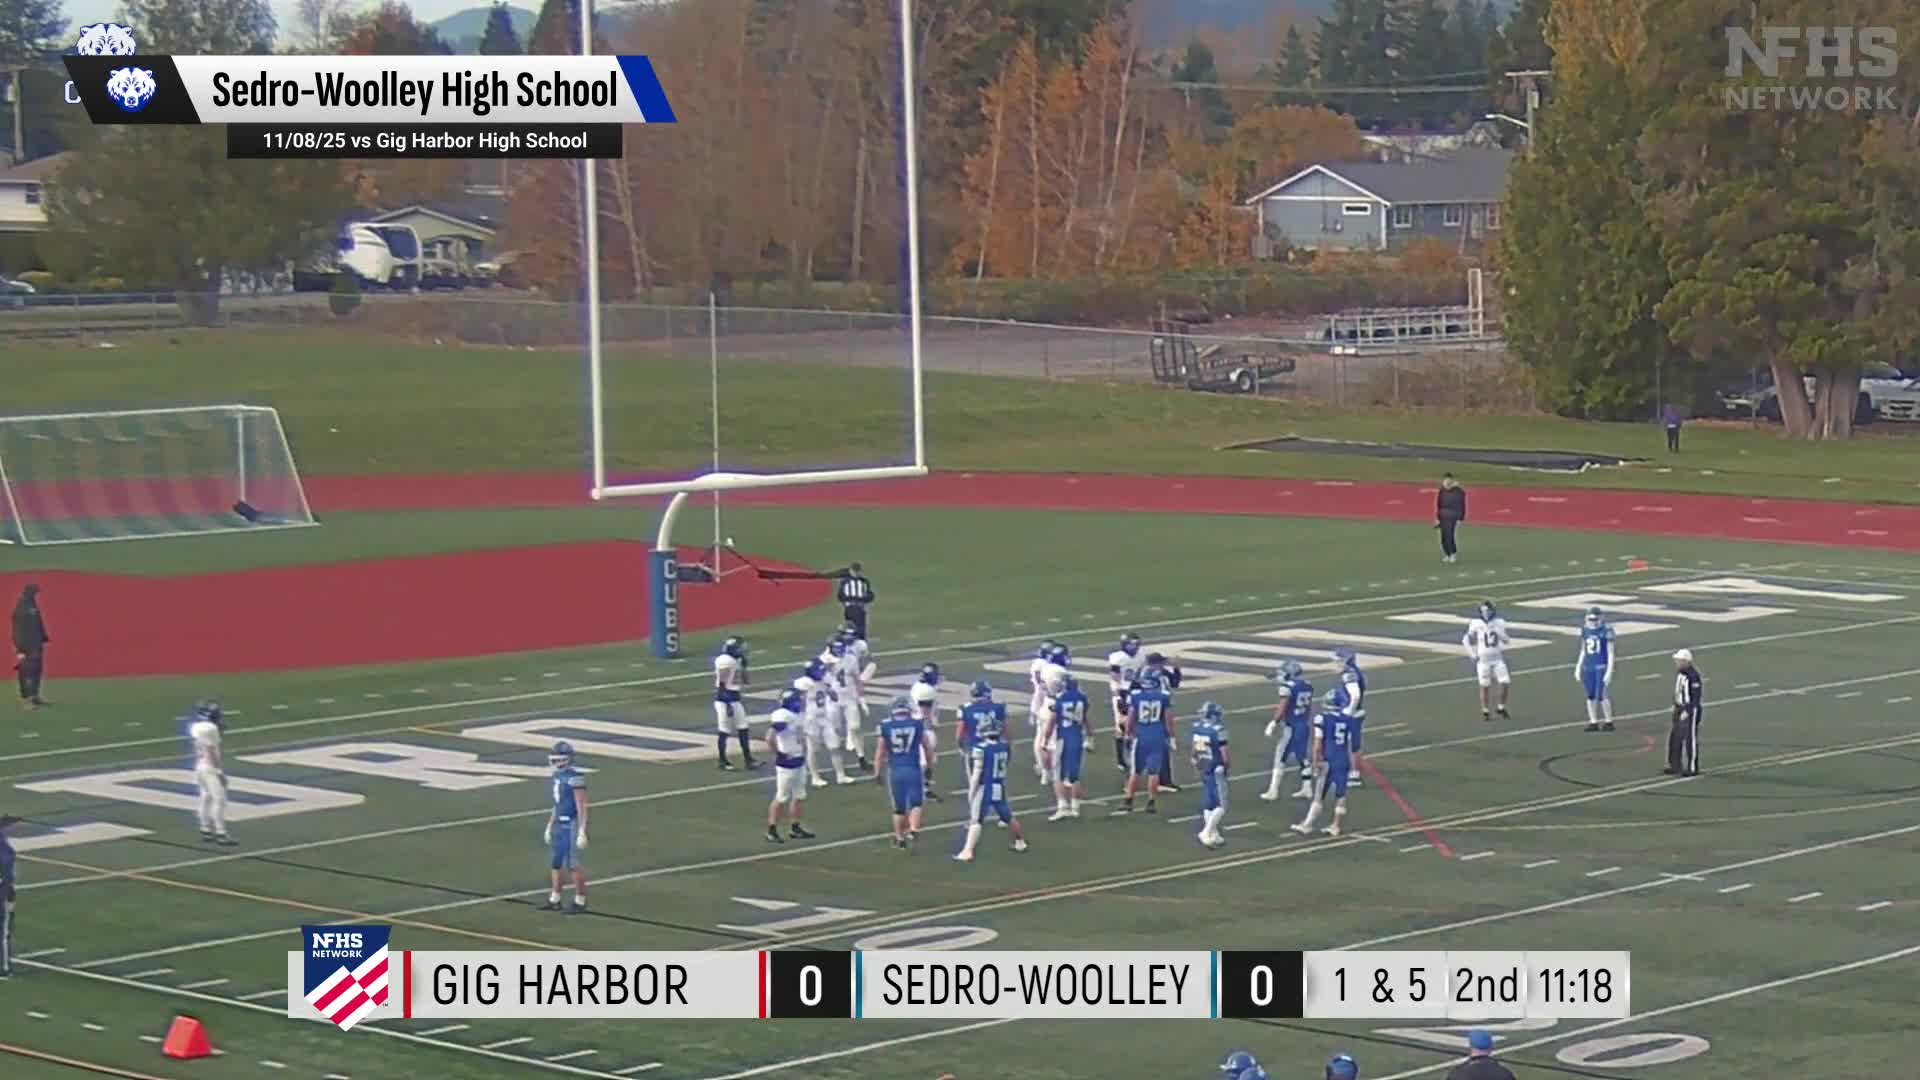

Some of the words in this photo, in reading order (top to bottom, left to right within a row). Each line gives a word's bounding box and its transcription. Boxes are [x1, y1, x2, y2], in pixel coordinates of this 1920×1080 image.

[663, 559, 678, 653] CUBS
[890, 726, 916, 752] 57
[1335, 722, 1347, 745] 5
